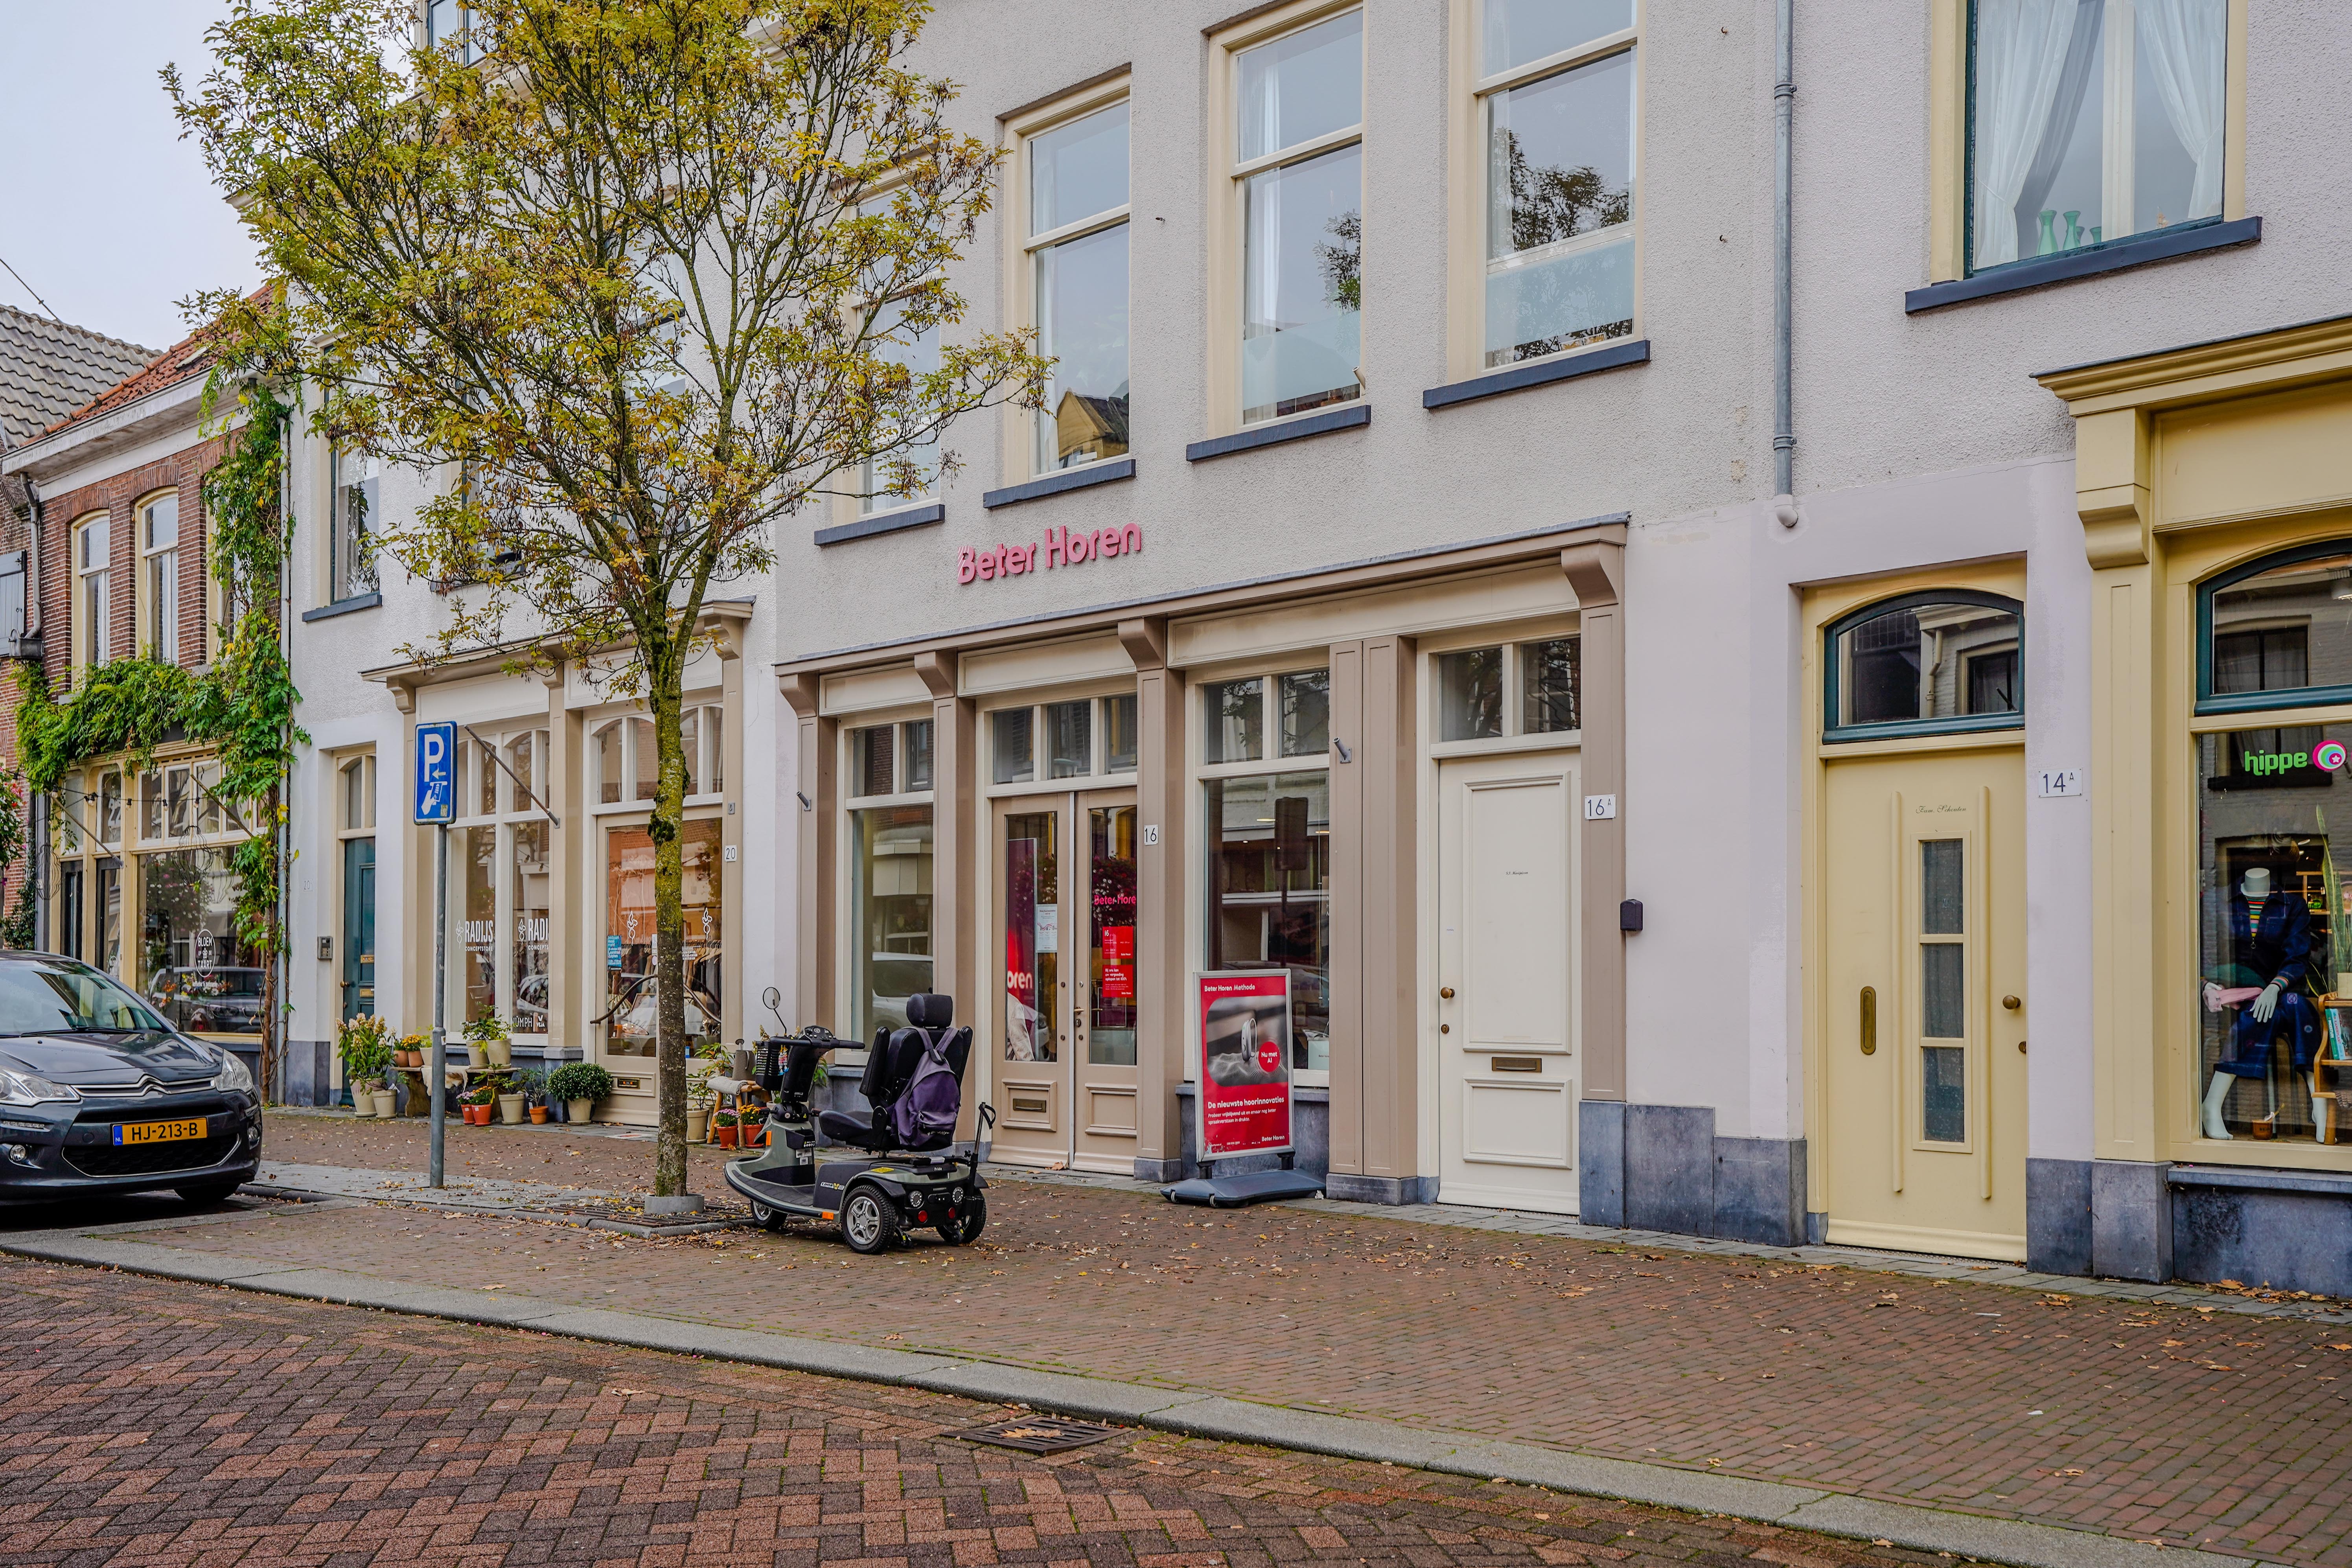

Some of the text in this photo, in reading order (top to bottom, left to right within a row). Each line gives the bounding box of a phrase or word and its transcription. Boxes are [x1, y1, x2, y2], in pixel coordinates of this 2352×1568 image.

[957, 523, 1141, 584] Beter Horen
[424, 733, 444, 782] P
[2244, 749, 2308, 776] hippe
[1937, 804, 1966, 813] Schouten
[1145, 827, 1157, 842] 16
[726, 848, 736, 859] 20
[1094, 894, 1115, 905] Beter
[465, 920, 493, 942] RADIJS
[528, 918, 549, 941] RADI
[198, 937, 213, 947] BLOEM
[197, 960, 213, 970] TAART
[1007, 970, 1033, 989] oren
[1244, 1096, 1285, 1106] hoorinnovaties
[132, 1122, 198, 1141] HJ-213-B
